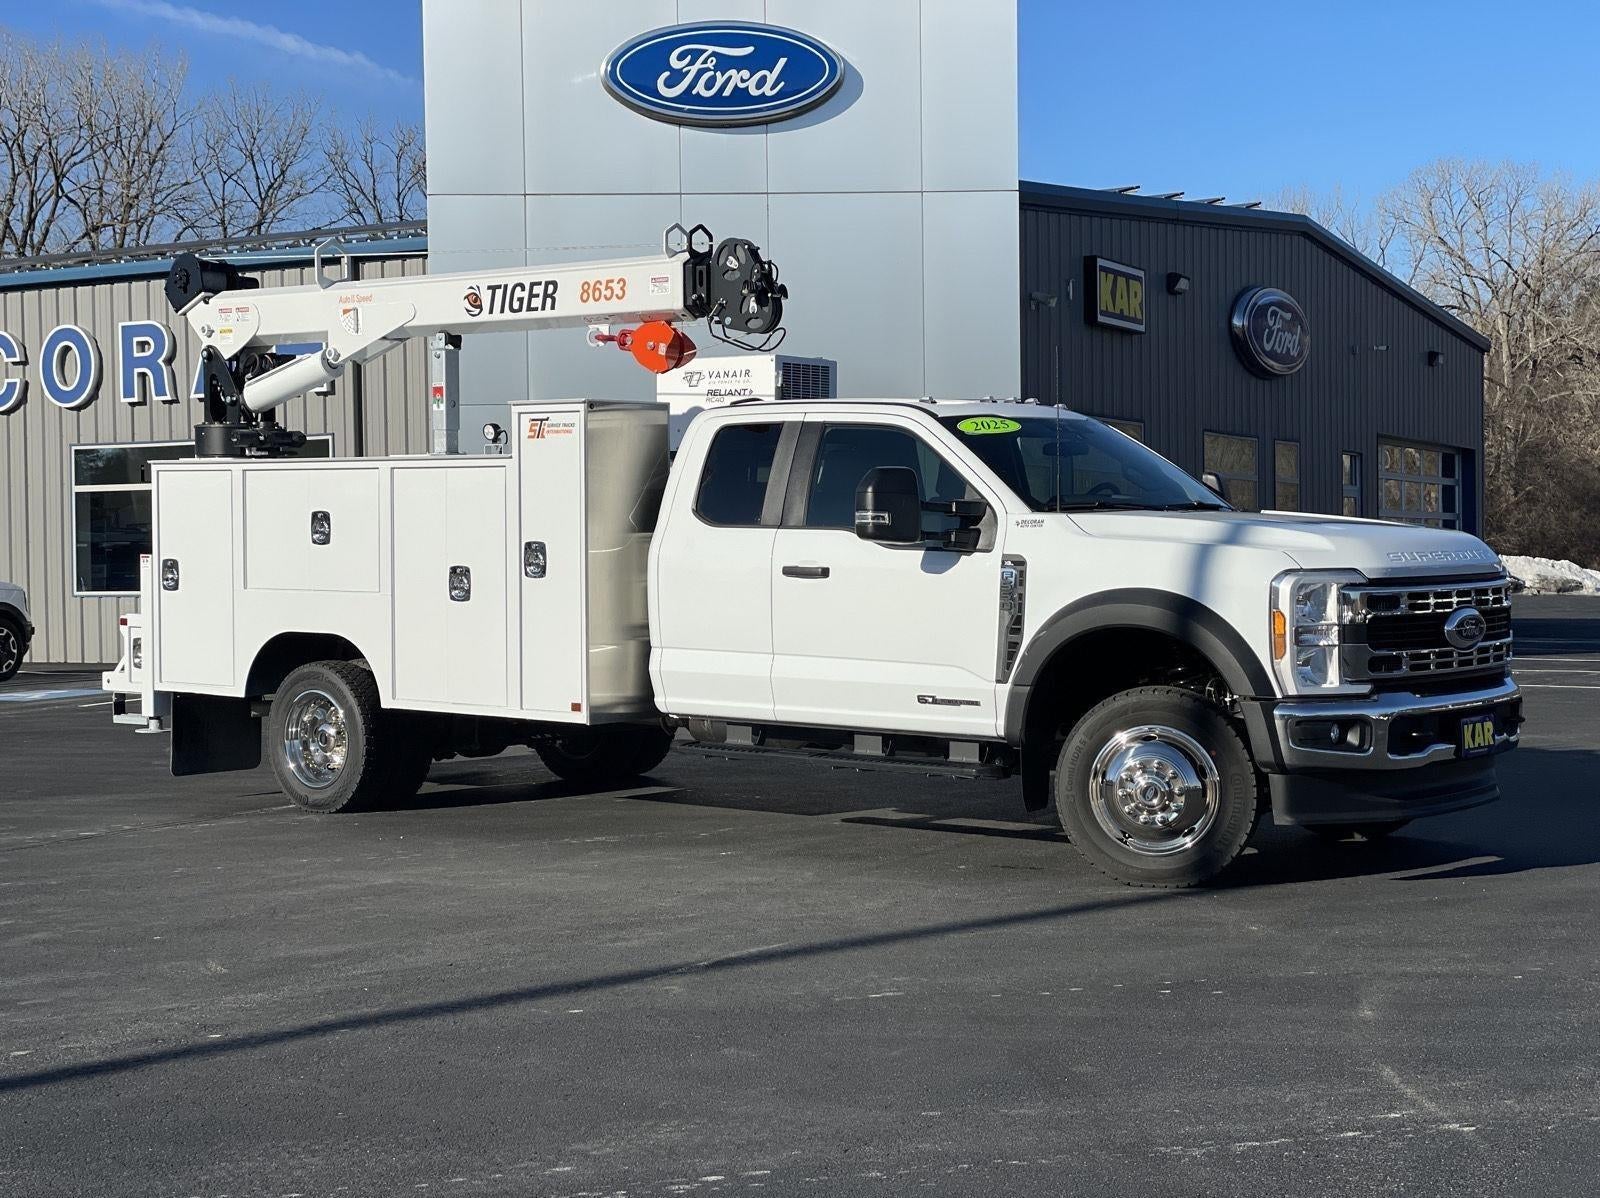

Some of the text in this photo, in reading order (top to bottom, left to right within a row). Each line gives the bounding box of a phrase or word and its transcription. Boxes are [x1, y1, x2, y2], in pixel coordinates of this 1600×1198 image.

[656, 44, 788, 98] Ford
[486, 280, 559, 315] TIGER
[579, 277, 627, 304] 8653
[1100, 270, 1143, 321] KAR
[1263, 305, 1301, 357] Ford
[708, 369, 751, 379] VANAIR
[706, 388, 748, 396] RELIANT
[970, 420, 1010, 431] 2025
[1463, 721, 1494, 749] KAR
